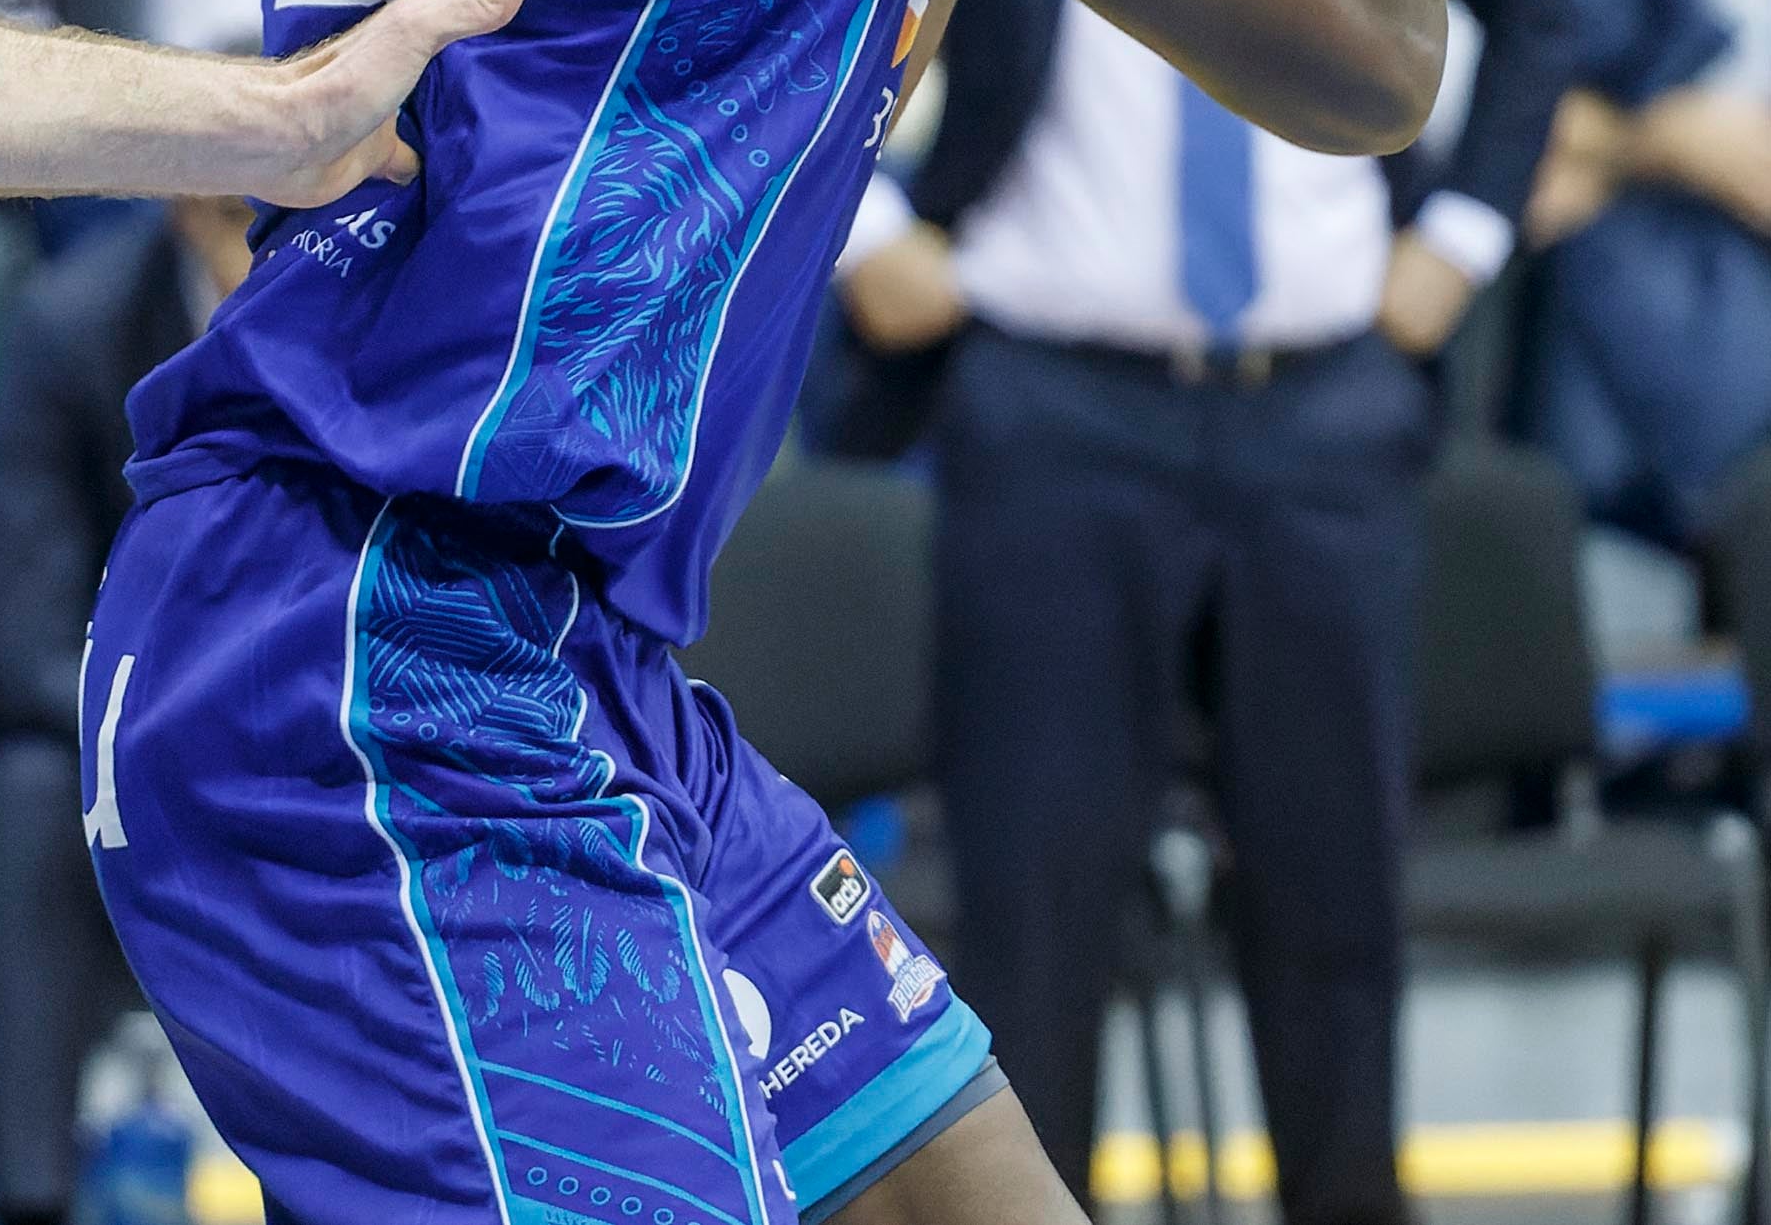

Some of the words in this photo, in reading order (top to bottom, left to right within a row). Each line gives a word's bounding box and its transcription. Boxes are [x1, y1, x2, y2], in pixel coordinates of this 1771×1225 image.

[830, 877, 862, 915] acb
[894, 959, 939, 1011] BURGOS
[757, 1006, 866, 1099] HEREDA
